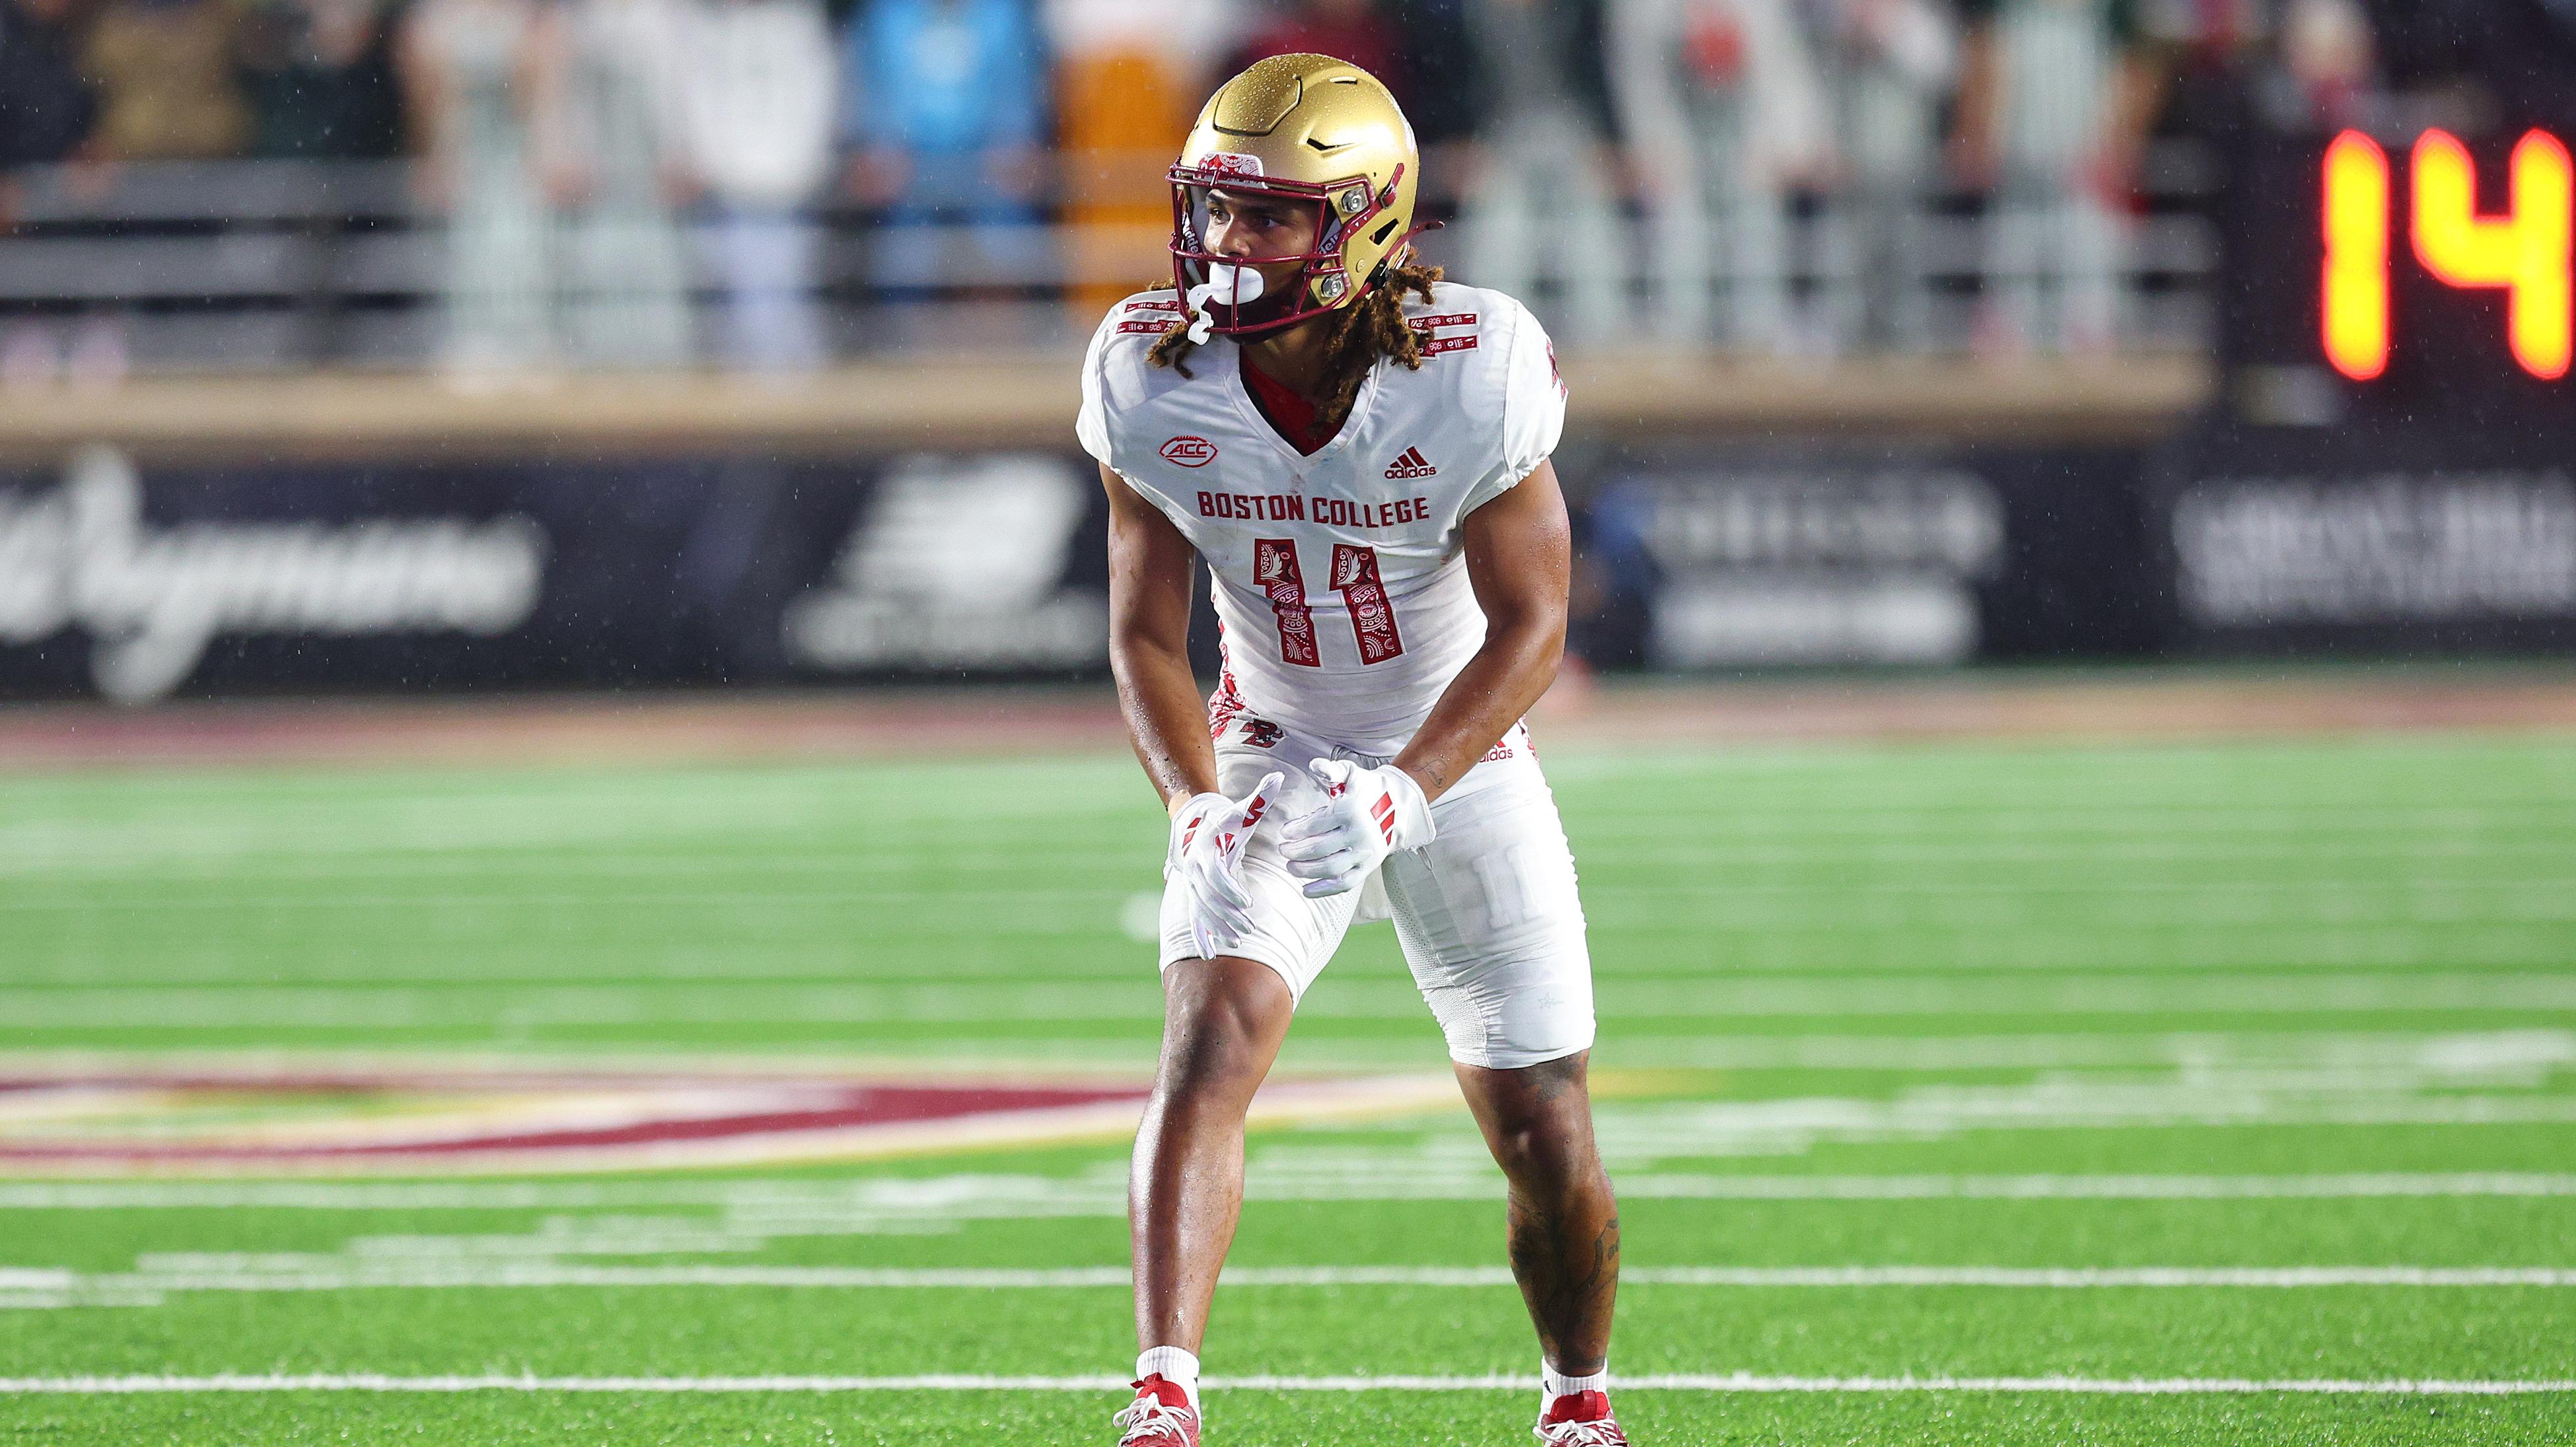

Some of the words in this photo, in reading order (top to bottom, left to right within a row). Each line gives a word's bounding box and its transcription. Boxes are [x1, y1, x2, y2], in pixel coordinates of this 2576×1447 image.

[2322, 127, 2574, 380] 14
[1168, 443, 1208, 455] ACC
[1384, 465, 1436, 479] adidas
[1197, 491, 1305, 520] BOSTON
[1312, 497, 1429, 528] COLLEGE
[1253, 538, 1404, 668] 11
[1480, 748, 1513, 763] idas
